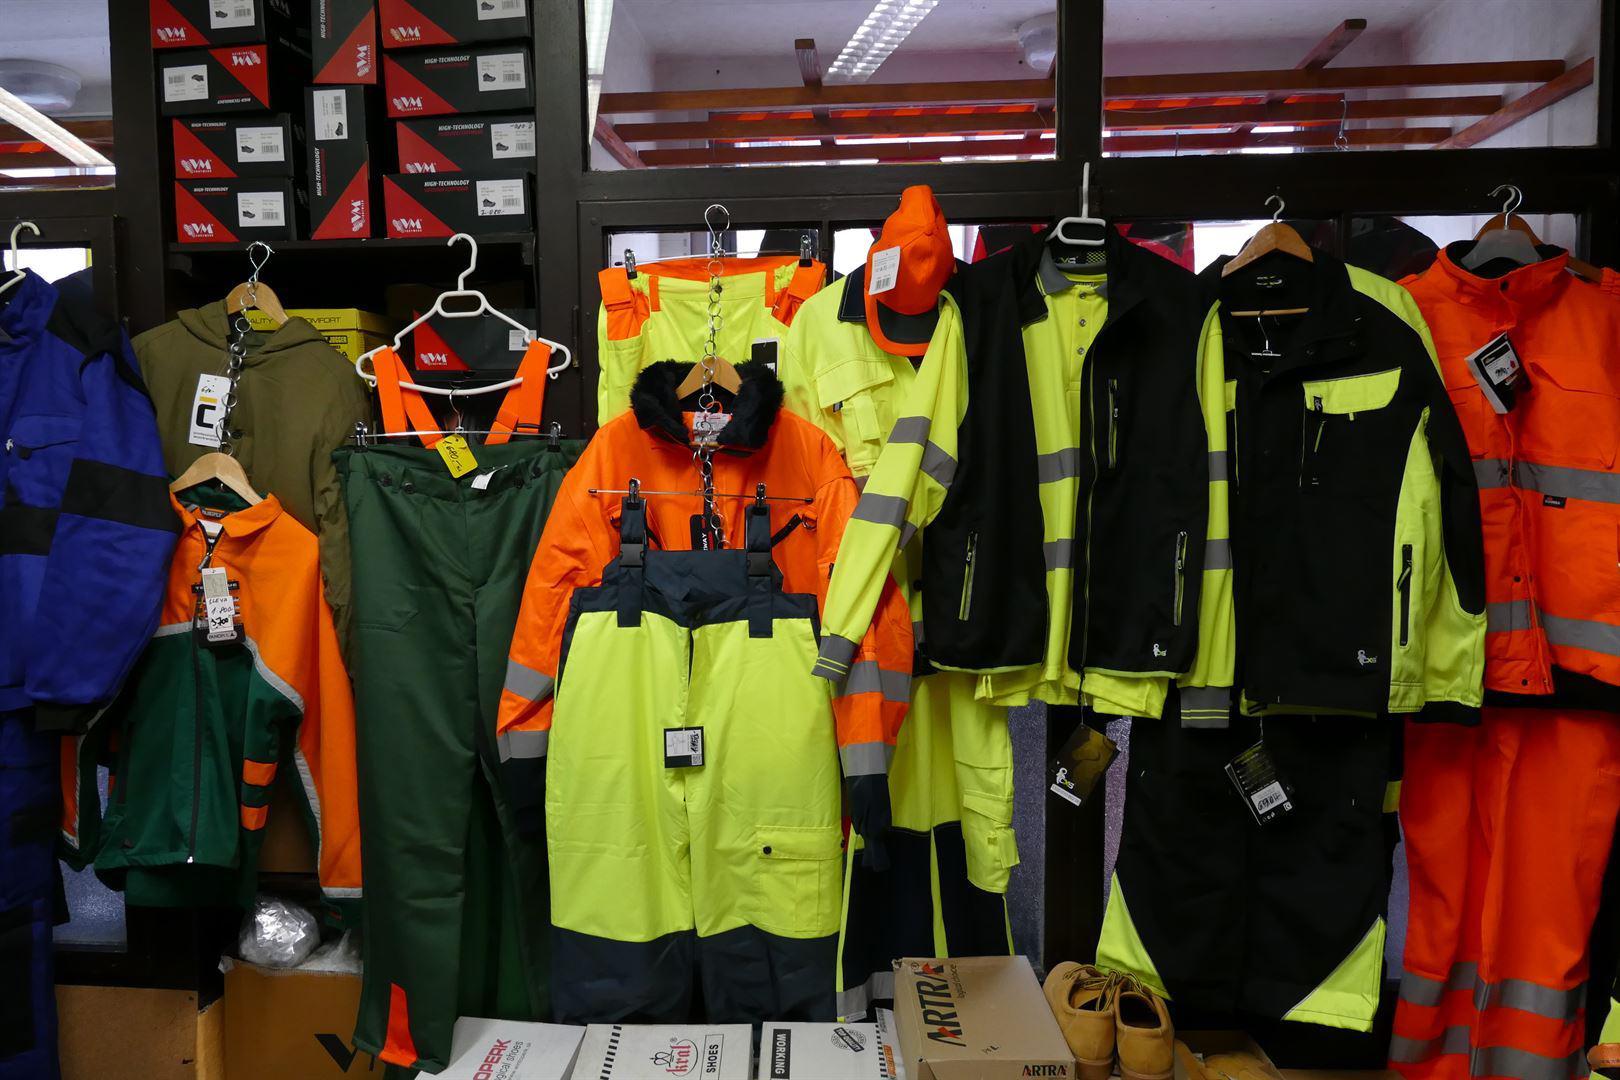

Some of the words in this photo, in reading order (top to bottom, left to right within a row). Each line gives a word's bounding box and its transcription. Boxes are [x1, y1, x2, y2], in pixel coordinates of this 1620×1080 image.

[424, 56, 471, 65] HIGH-TECHNOLOGY
[438, 123, 485, 132] HIGH-TECHNOLOGY
[314, 147, 322, 197] HIGH-TECHNOLOGY
[914, 963, 967, 1047] ARTRA
[706, 1044, 719, 1073] SHOES
[774, 1033, 787, 1075] WORKING
[1022, 1064, 1067, 1077] ARTRA
